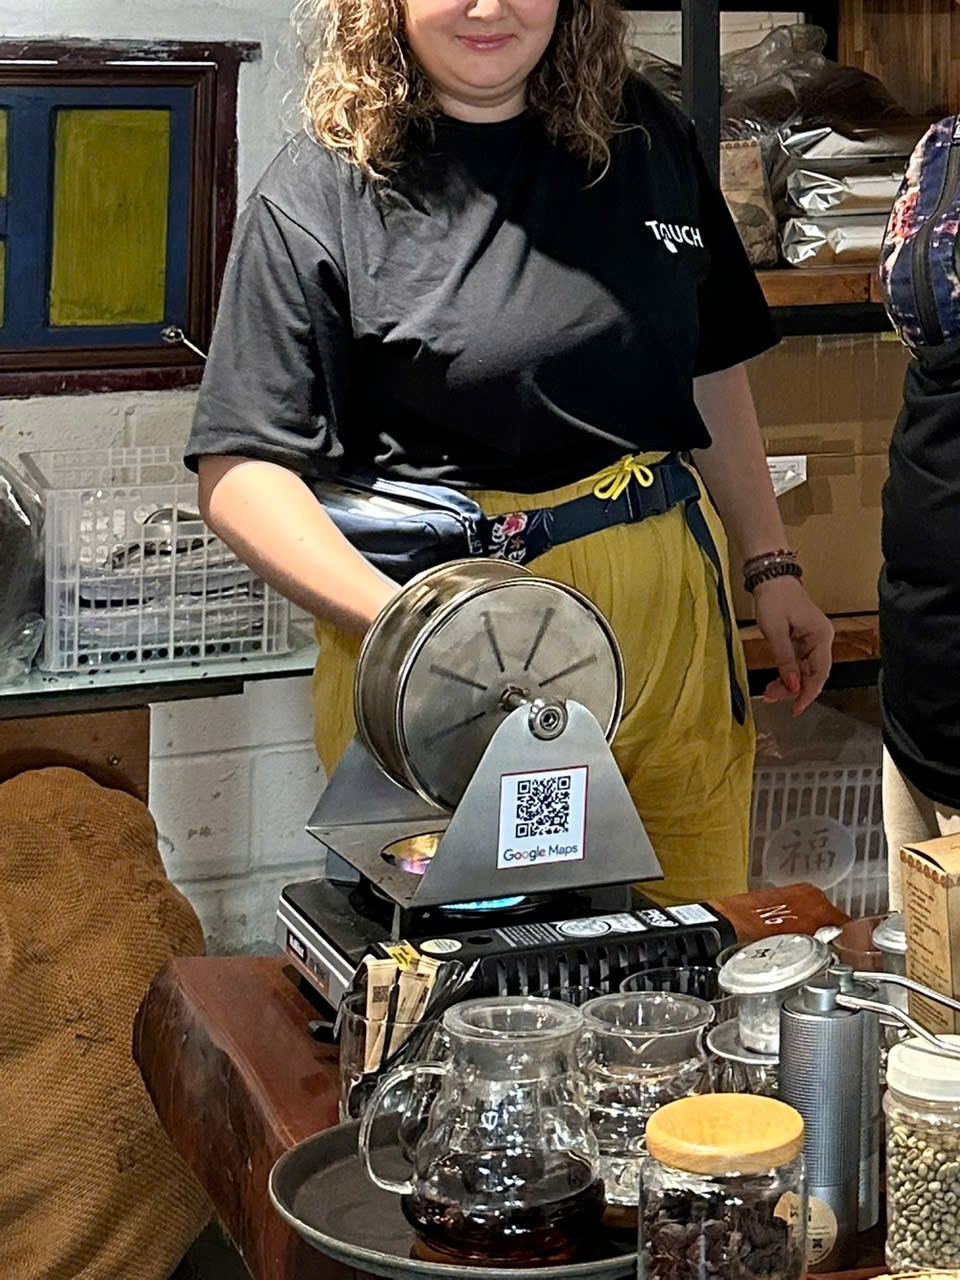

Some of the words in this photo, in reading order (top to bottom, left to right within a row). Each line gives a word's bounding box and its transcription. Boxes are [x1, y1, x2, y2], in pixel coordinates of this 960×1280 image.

[644, 220, 705, 253] TOUCH
[503, 845, 546, 862] Google
[548, 844, 578, 857] Maps
